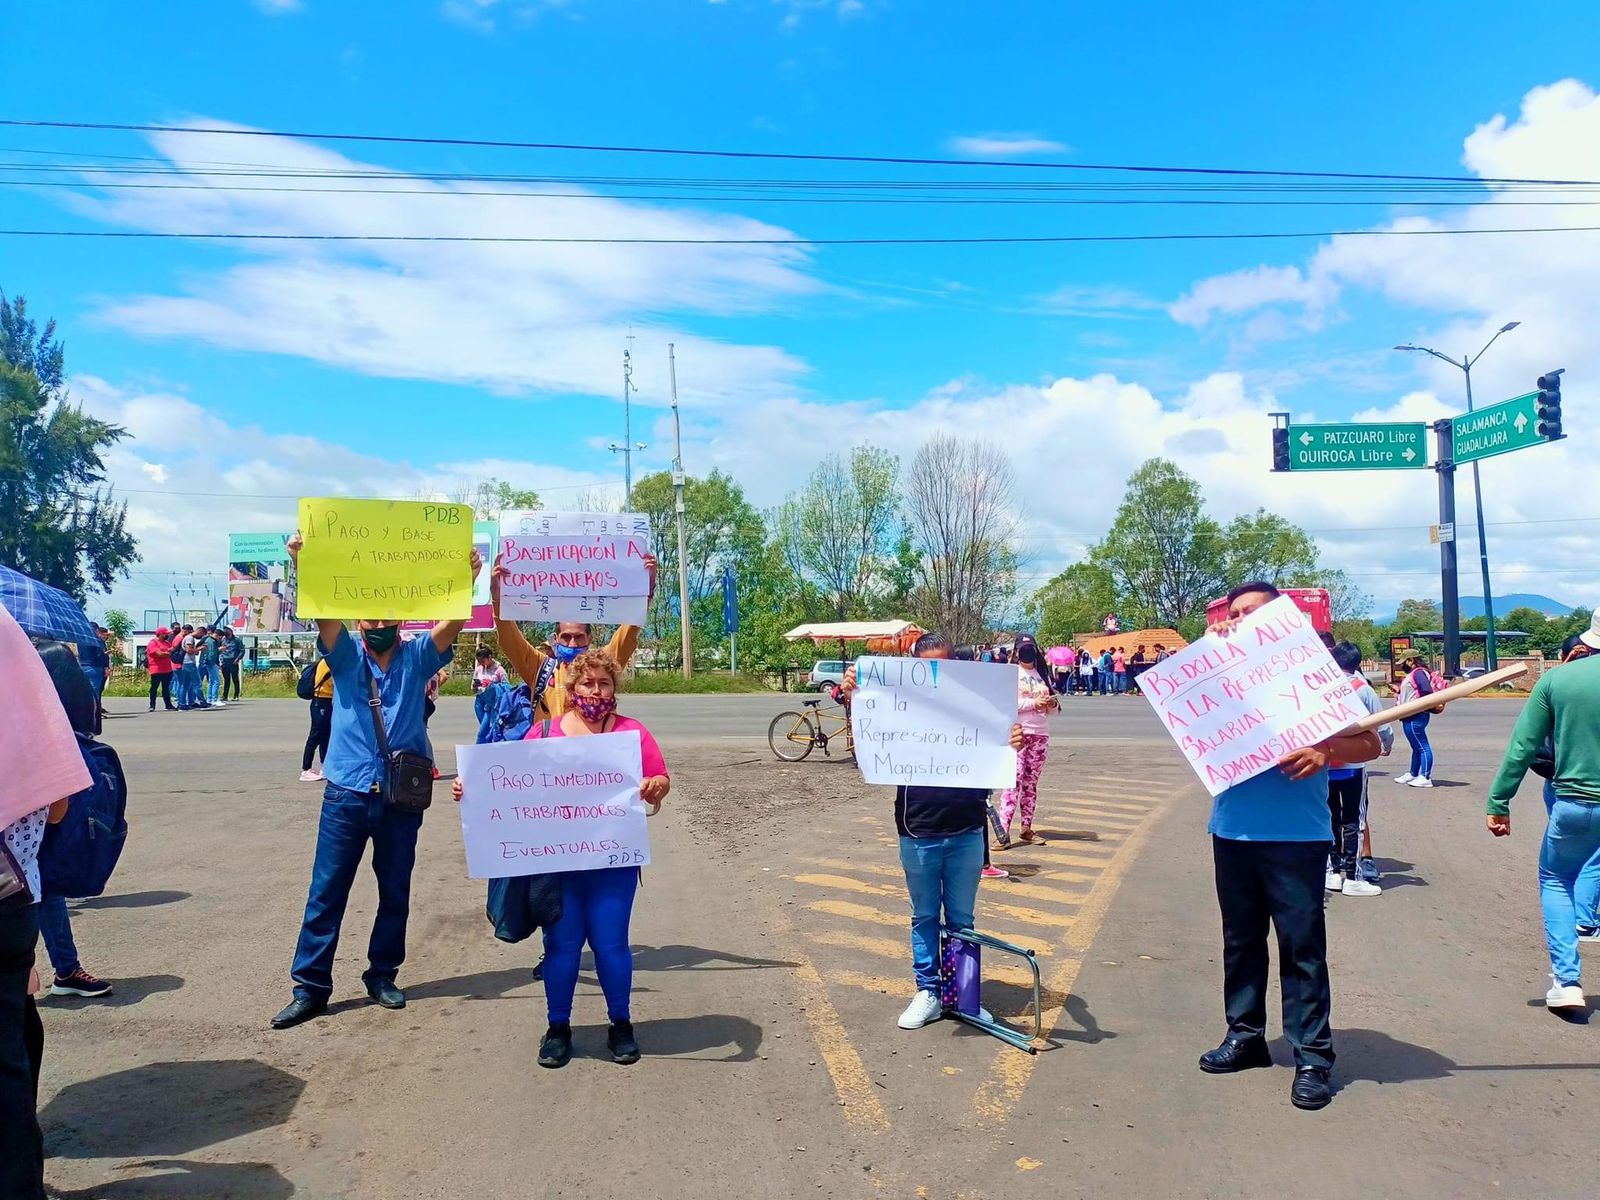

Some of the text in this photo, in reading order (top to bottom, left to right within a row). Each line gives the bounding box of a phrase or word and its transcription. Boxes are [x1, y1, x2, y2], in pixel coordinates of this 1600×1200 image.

[1324, 430, 1416, 444] PATZCUARO Libre
[1456, 411, 1508, 437] SALAMANCA
[1300, 449, 1393, 463] QUIROGA Libre
[1456, 431, 1508, 455] GUADALAJARA
[402, 527, 436, 541] BASE
[351, 549, 464, 564] A TRABAJADORES
[505, 536, 645, 564] BASIFICACIÓN A
[333, 575, 454, 602] EVENTUALES!
[503, 569, 618, 592] COMPAÑEROS
[1144, 642, 1247, 705] BEDOLLA
[866, 693, 907, 711] a la
[1322, 685, 1352, 703] PDB
[1167, 710, 1190, 730] A
[1186, 693, 1220, 718] LA
[1181, 660, 1341, 760] SALARIAL Y CNTE
[859, 718, 978, 749] Represión del
[1205, 702, 1359, 786] ADMINISTRATIVA
[487, 765, 623, 791] PAGO INMEDIATO
[874, 752, 970, 782] Magisterio
[490, 804, 627, 821] A TRABAJADORES
